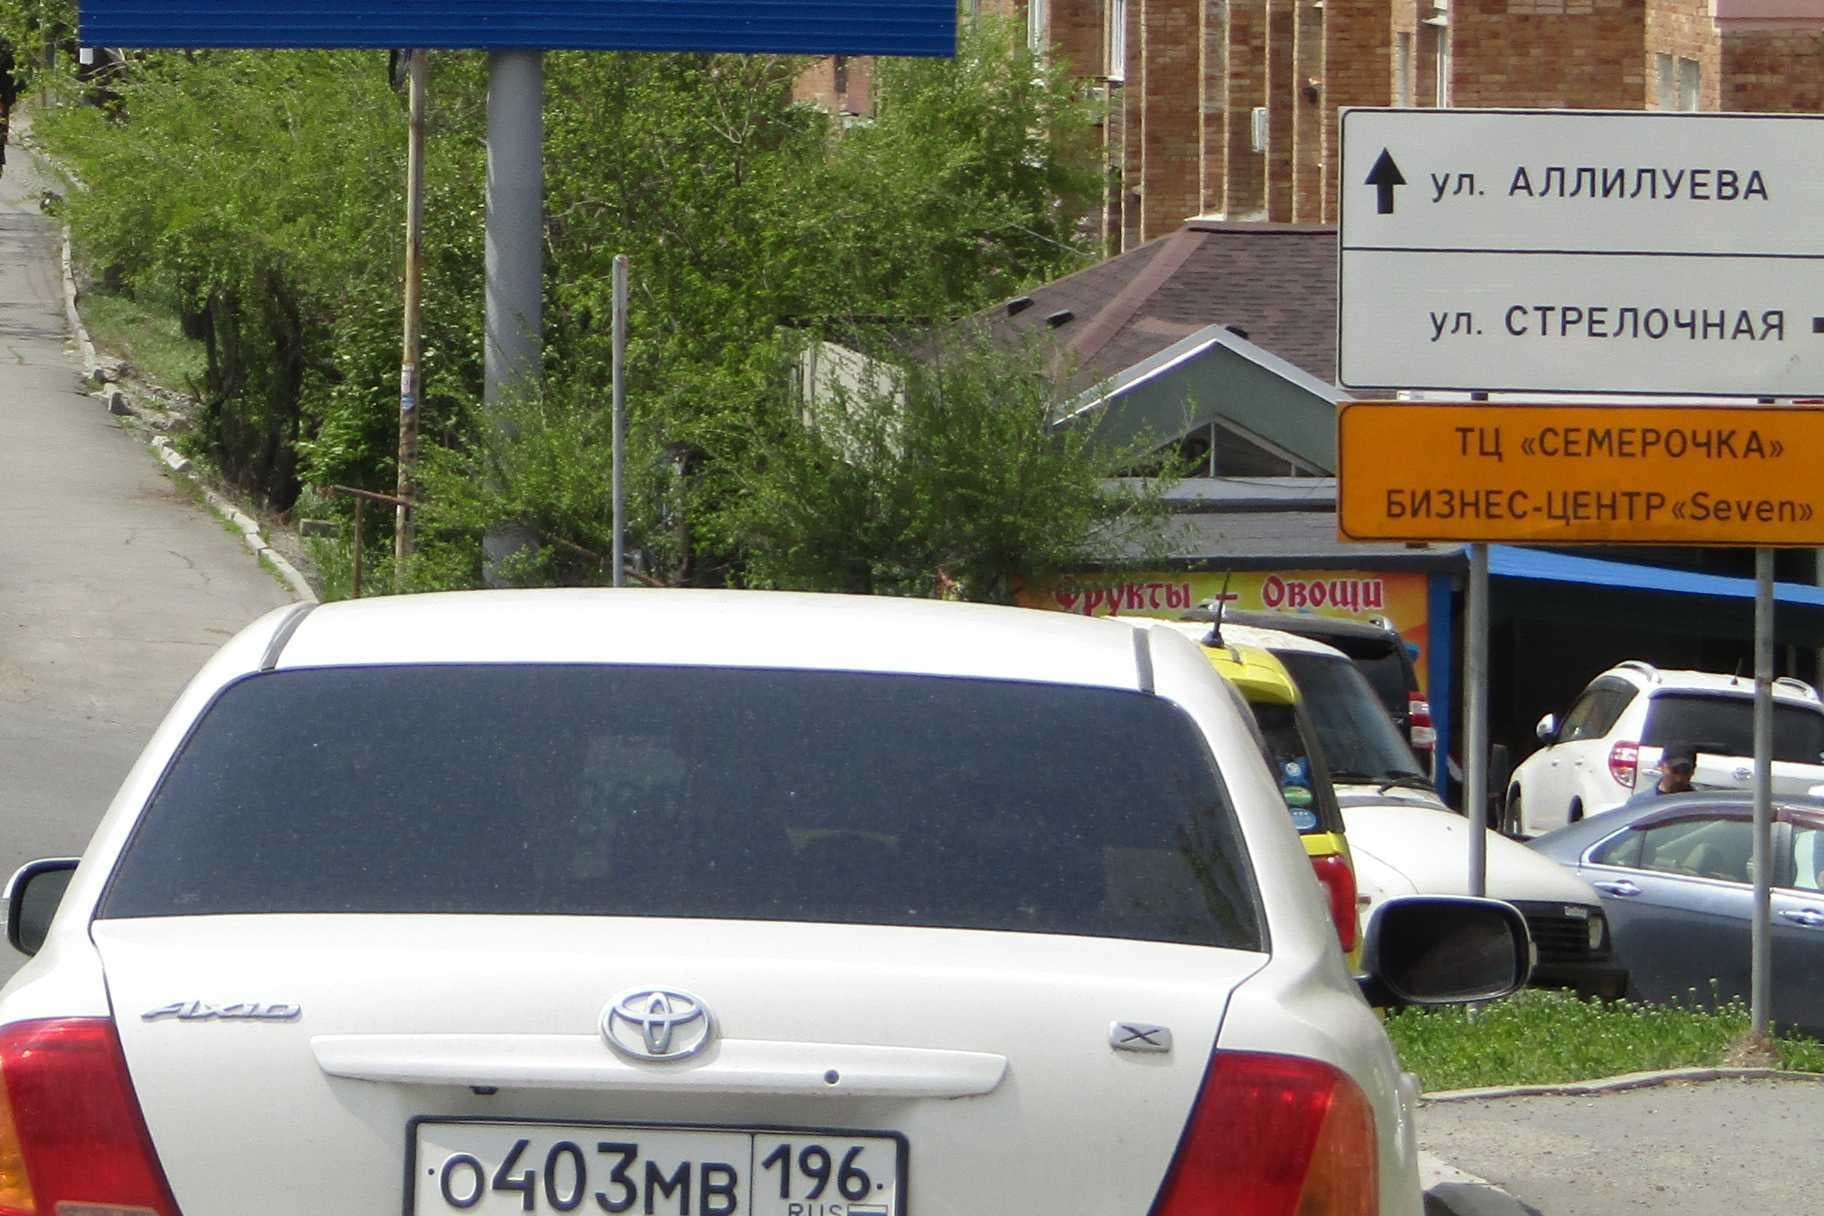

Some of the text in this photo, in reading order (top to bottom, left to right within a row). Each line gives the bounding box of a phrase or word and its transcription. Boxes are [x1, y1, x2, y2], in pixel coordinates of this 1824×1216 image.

[1430, 166, 1769, 203] ул. АЛЛИЛУЕВА
[1429, 304, 1785, 342] ул. СТРЕЛОЧНАЯ
[1455, 426, 1784, 462] ТЦ «СЕМЕРОЧКА»
[1385, 488, 1814, 526] БИЗНЕС-ЦЕНТР «Seven»
[1262, 575, 1384, 613] Овощи
[1120, 1025, 1161, 1046] X
[439, 1138, 872, 1215] О403МВ 196
